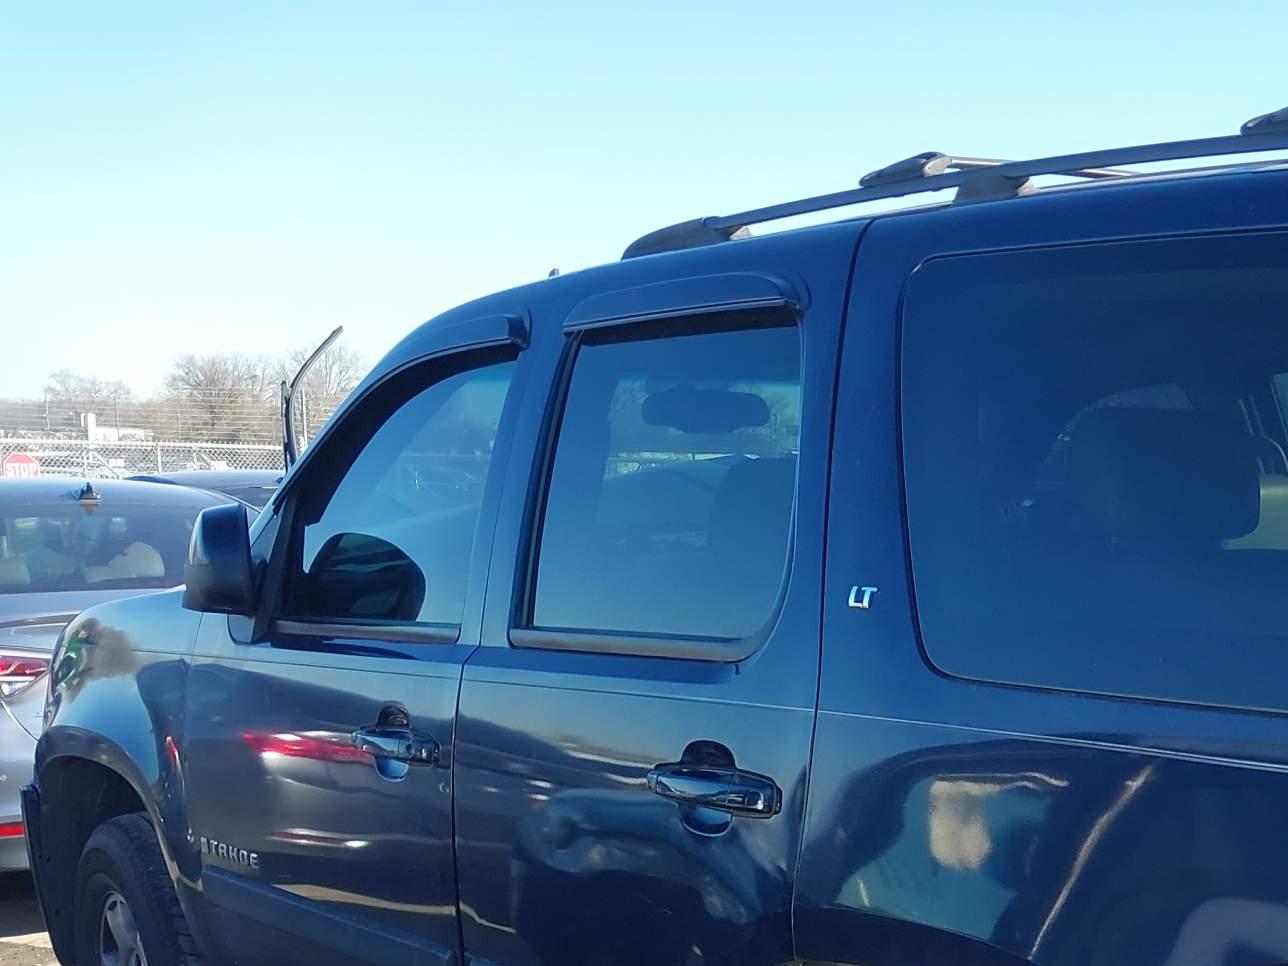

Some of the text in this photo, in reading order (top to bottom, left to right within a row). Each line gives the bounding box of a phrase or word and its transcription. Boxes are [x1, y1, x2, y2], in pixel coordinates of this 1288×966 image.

[6, 463, 38, 479] STOP
[848, 585, 878, 608] LT
[208, 838, 259, 868] TAHOE
